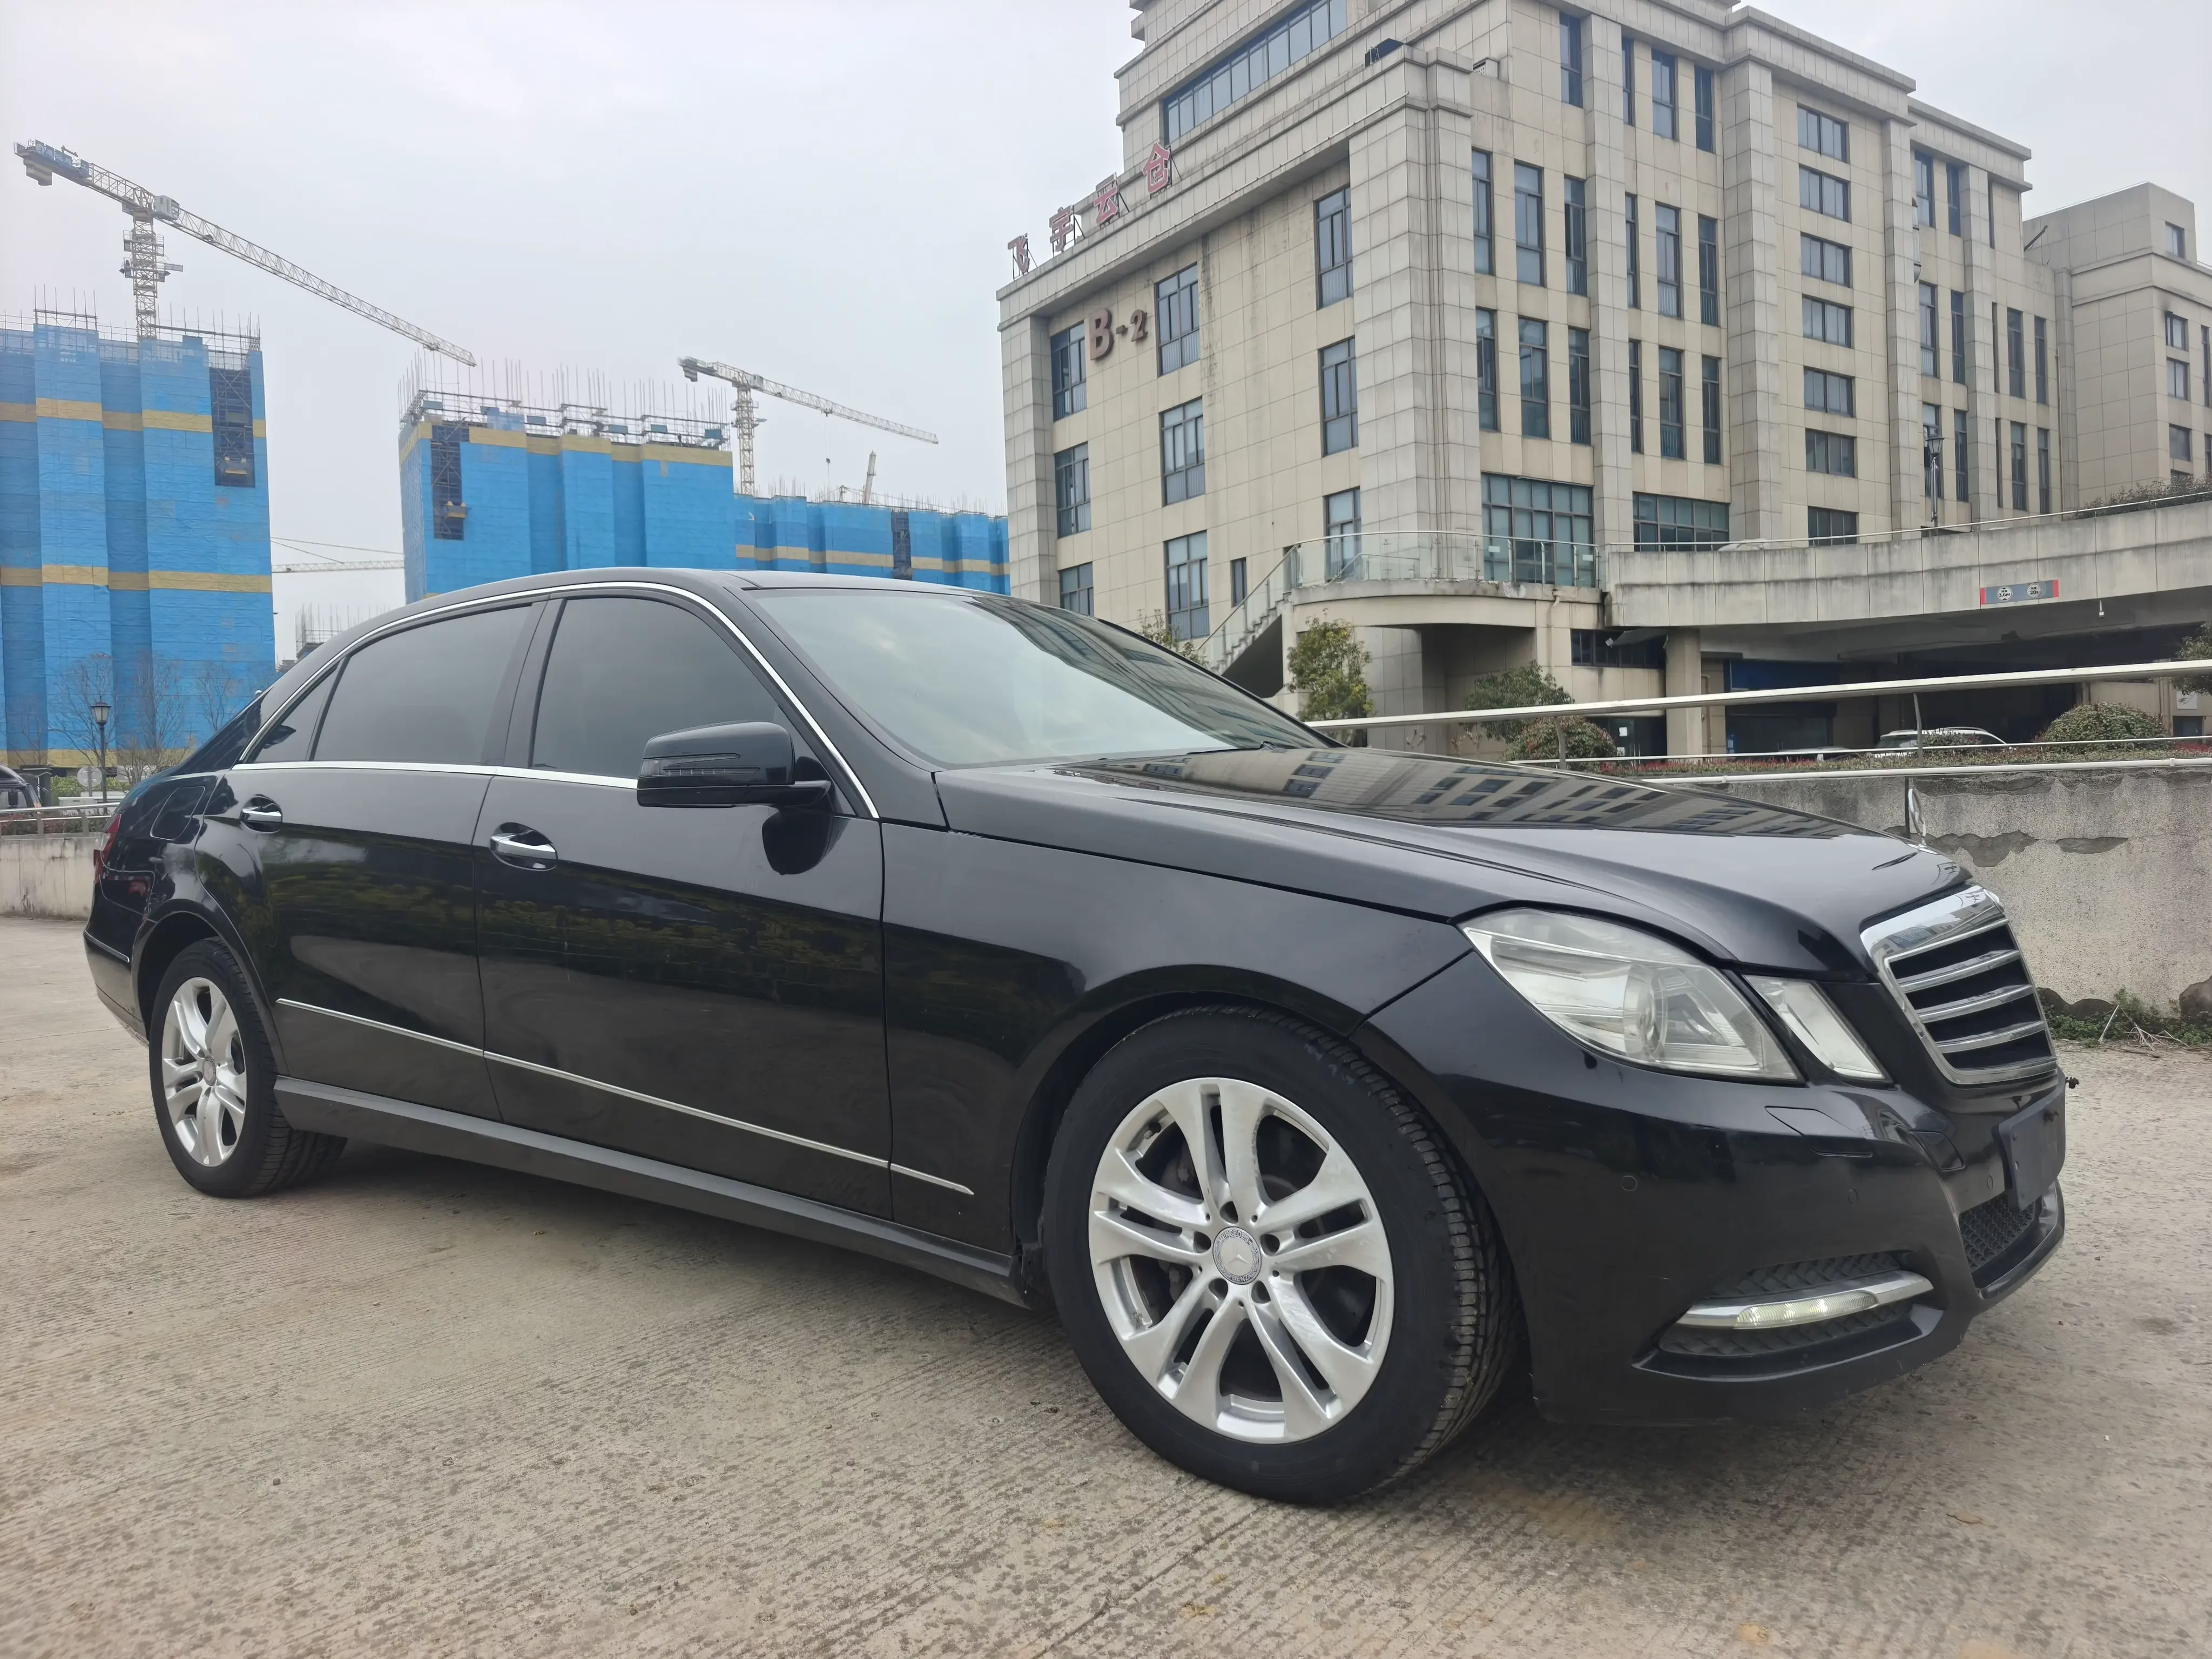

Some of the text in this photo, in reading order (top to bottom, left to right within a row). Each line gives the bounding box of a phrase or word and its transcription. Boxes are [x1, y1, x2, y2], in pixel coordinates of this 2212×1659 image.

[1008, 141, 1171, 274] 飞宇云仓
[1089, 308, 1147, 361] B-2
[1219, 1230, 1249, 1243] MERCEDES
[1232, 1274, 1249, 1282] BENZ
